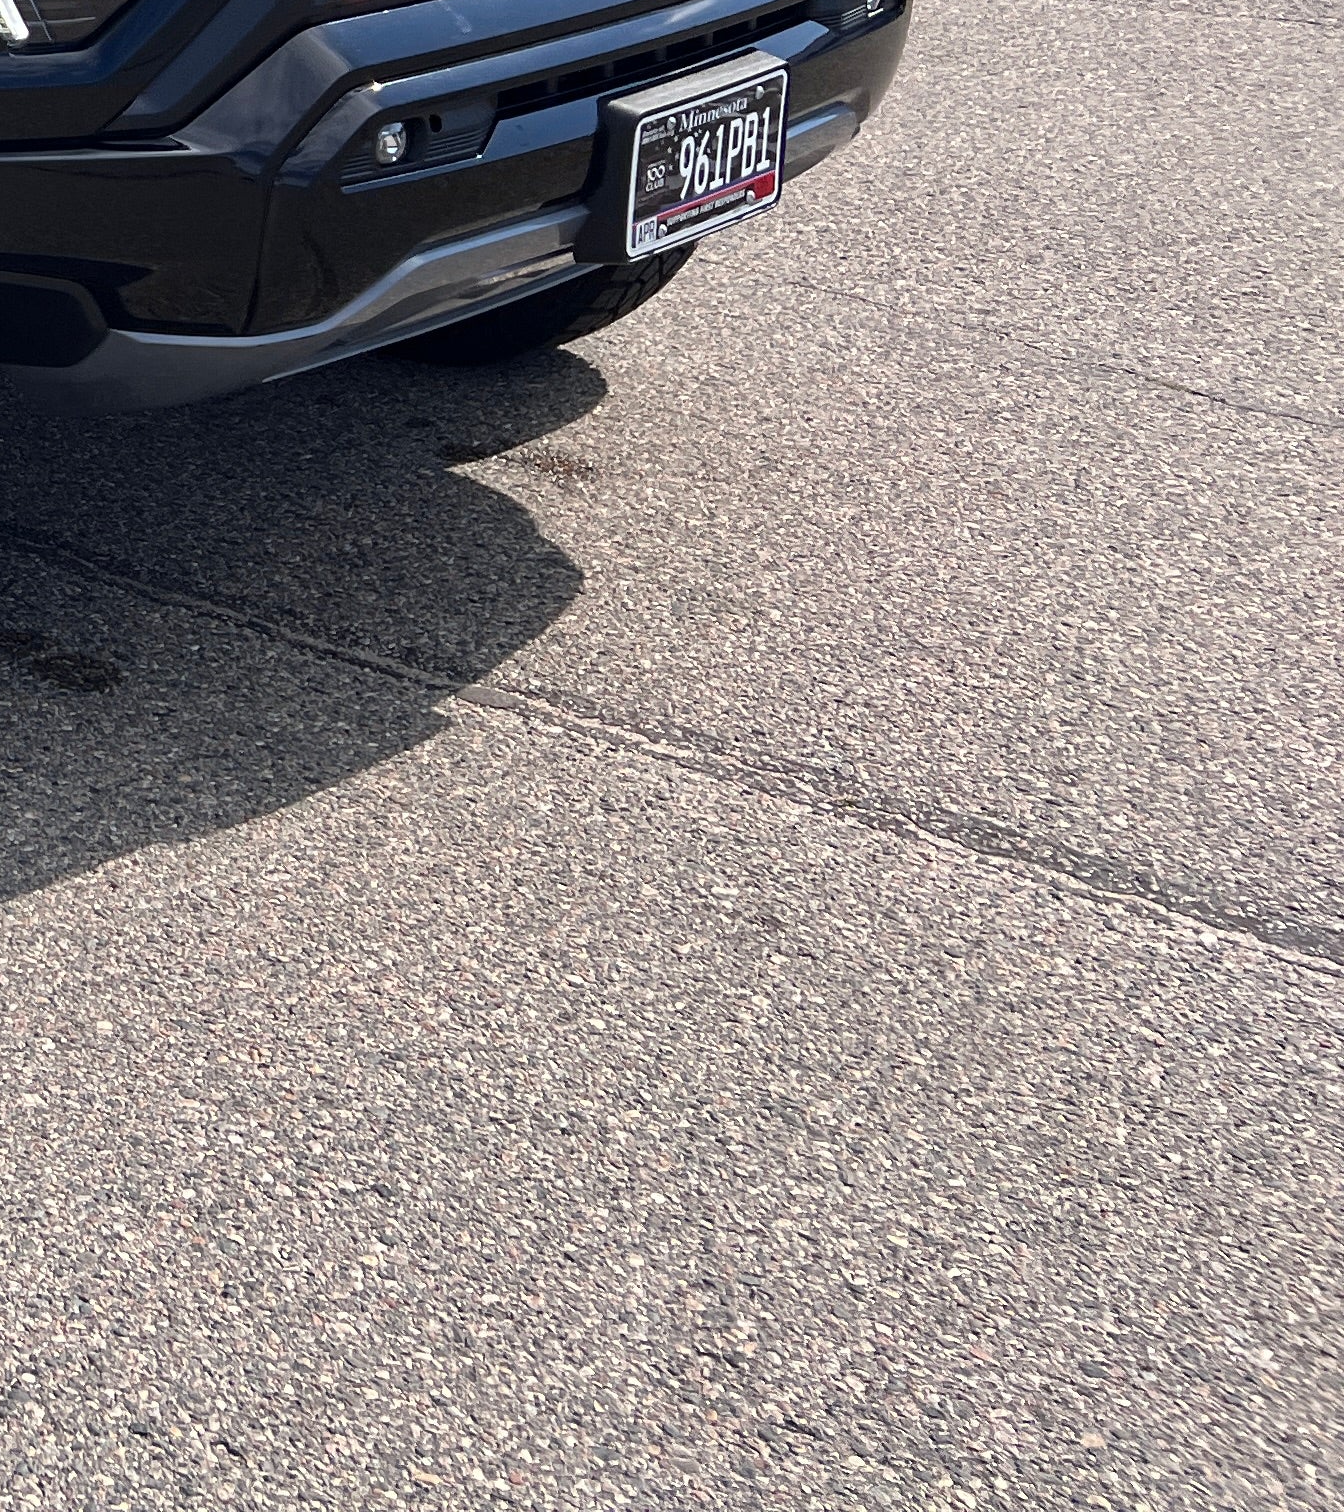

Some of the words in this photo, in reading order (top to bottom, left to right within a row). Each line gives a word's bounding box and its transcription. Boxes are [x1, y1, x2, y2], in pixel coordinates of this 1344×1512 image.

[678, 98, 748, 132] Minnesota
[679, 106, 771, 200] 961PB1
[638, 220, 656, 244] APR
